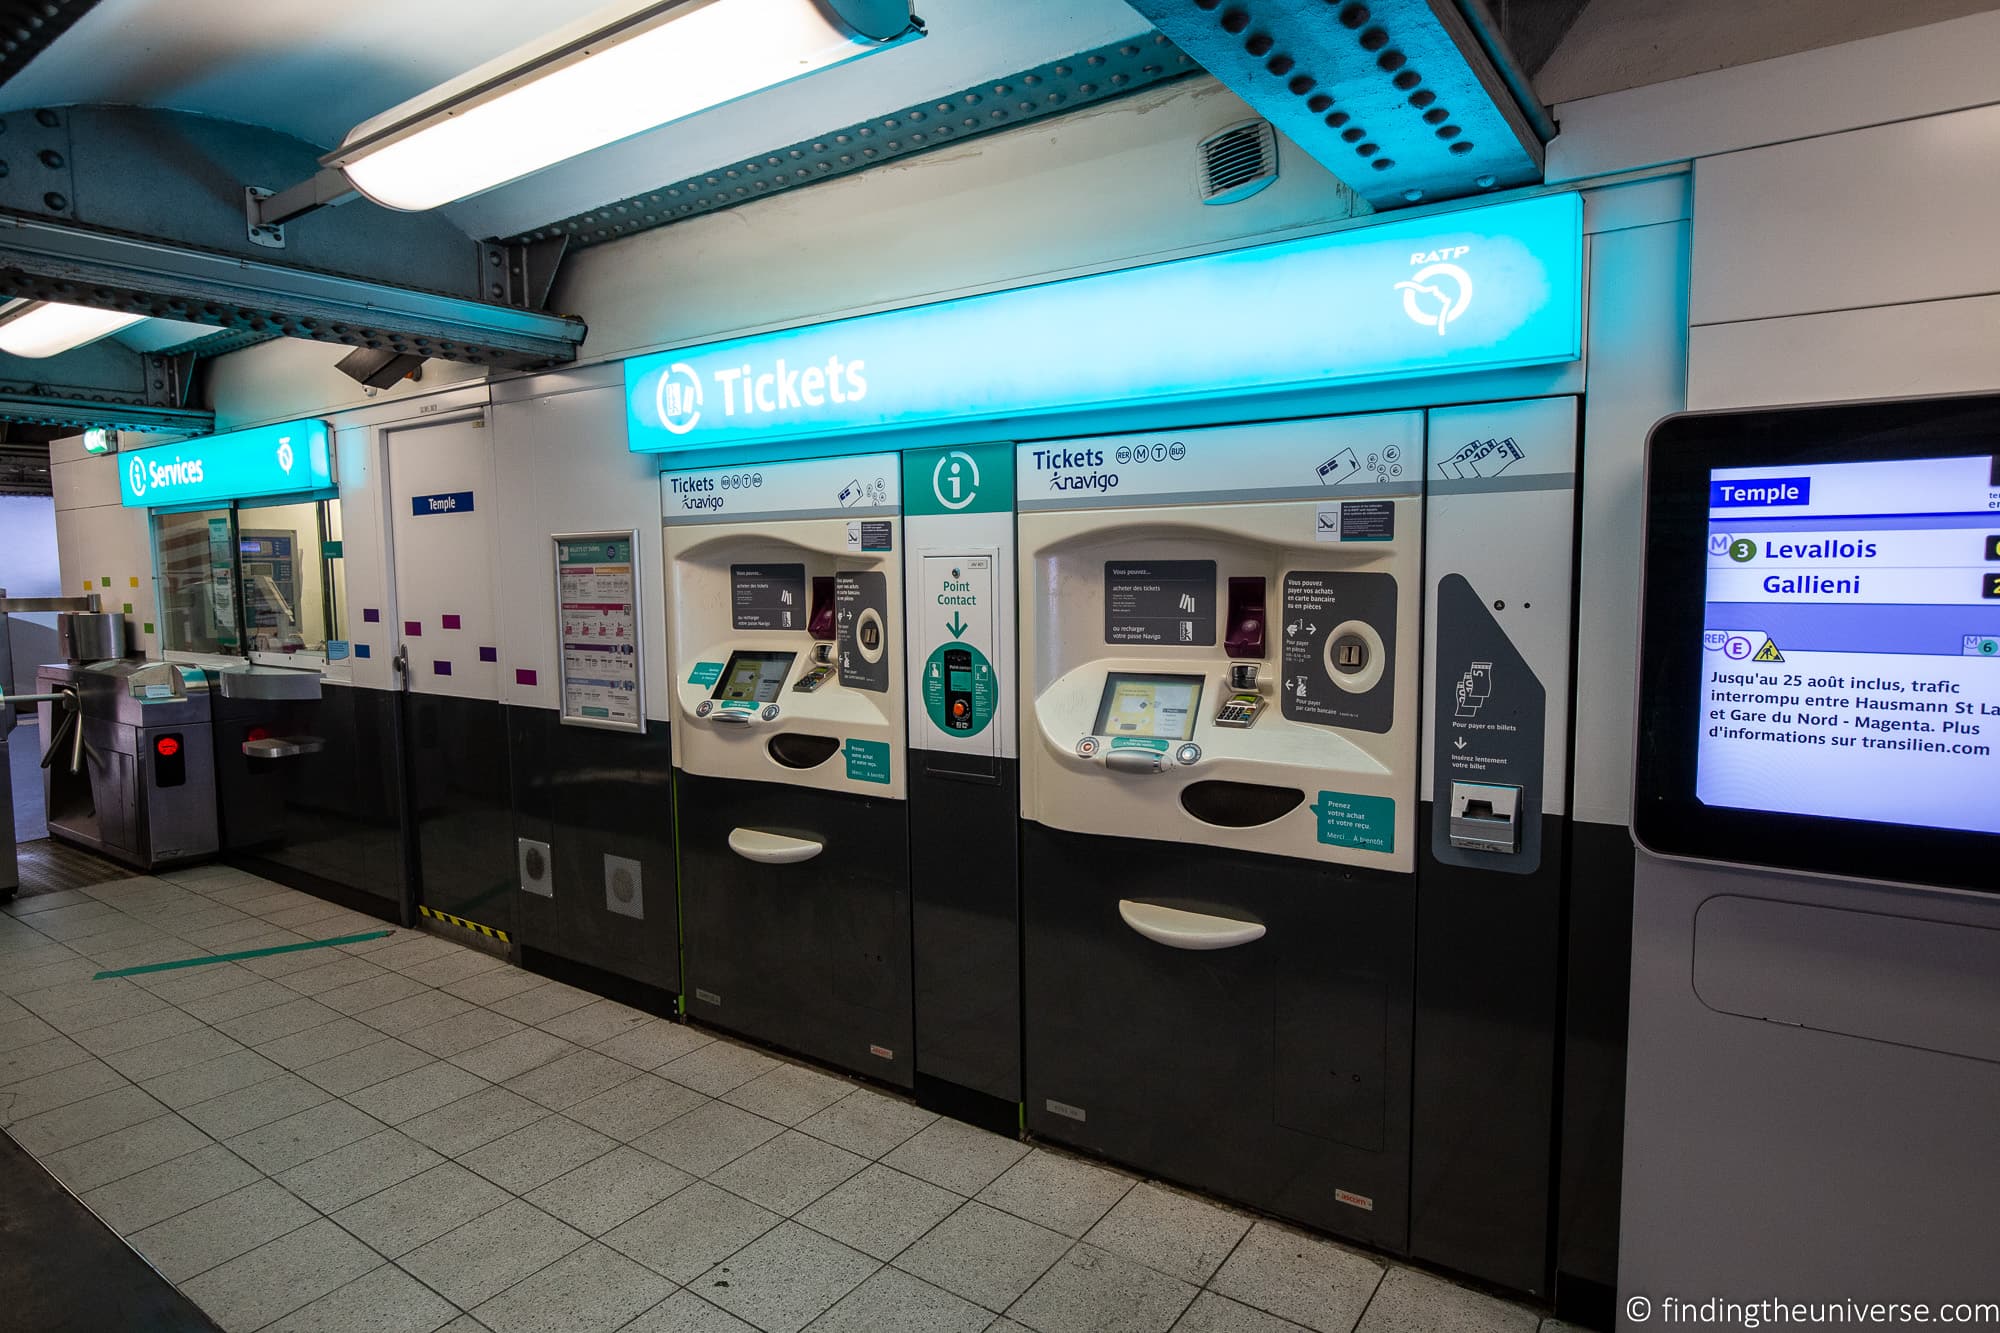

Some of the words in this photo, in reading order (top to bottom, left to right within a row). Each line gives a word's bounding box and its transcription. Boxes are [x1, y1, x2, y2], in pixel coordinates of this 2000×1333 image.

[1410, 246, 1470, 265] RATP
[714, 355, 867, 416] Tickets
[1033, 449, 1104, 470] Tickets
[149, 456, 203, 488] Services
[671, 476, 714, 493] Tickets
[1063, 471, 1119, 492] navigo
[428, 495, 456, 511] Temple
[690, 495, 724, 511] navigo
[1720, 484, 1799, 504] Temple
[1711, 537, 1728, 549] M
[1737, 543, 1749, 556] 3
[1765, 540, 1877, 559] Levallois
[943, 580, 970, 592] Point
[1302, 580, 1323, 588] pouvez
[1763, 575, 1860, 594] Gallieni
[937, 594, 976, 605] Contact
[1310, 595, 1336, 603] bancaire
[1143, 633, 1161, 641] Navigo
[1705, 633, 1725, 644] RER
[1732, 643, 1743, 655] E
[1983, 642, 1992, 653] 6
[1711, 671, 1778, 686] Jusqu'au
[1783, 674, 1802, 687] 25
[1807, 675, 1845, 689] août
[1850, 677, 1905, 693] inclus,
[1912, 680, 1960, 694] trafic
[1711, 690, 1800, 707] interrompu
[1805, 695, 1849, 708] entre
[1855, 697, 1948, 713] Hausmann
[1955, 701, 1974, 715] St
[1710, 709, 1725, 720] et
[1730, 708, 1767, 723] Gare
[1772, 711, 1792, 724] du
[1797, 713, 1838, 726] Nord
[1855, 716, 1935, 733] Magenta.
[1943, 721, 1980, 735] Plus
[1709, 726, 1826, 746] d'informations
[1831, 735, 1857, 747] sur
[1862, 736, 1990, 756] transilien.com
[1451, 754, 1474, 762] Insérez
[1475, 756, 1507, 764] lentement
[1469, 762, 1486, 770] billet
[1328, 800, 1351, 809] Prenez
[1346, 812, 1365, 820] achat
